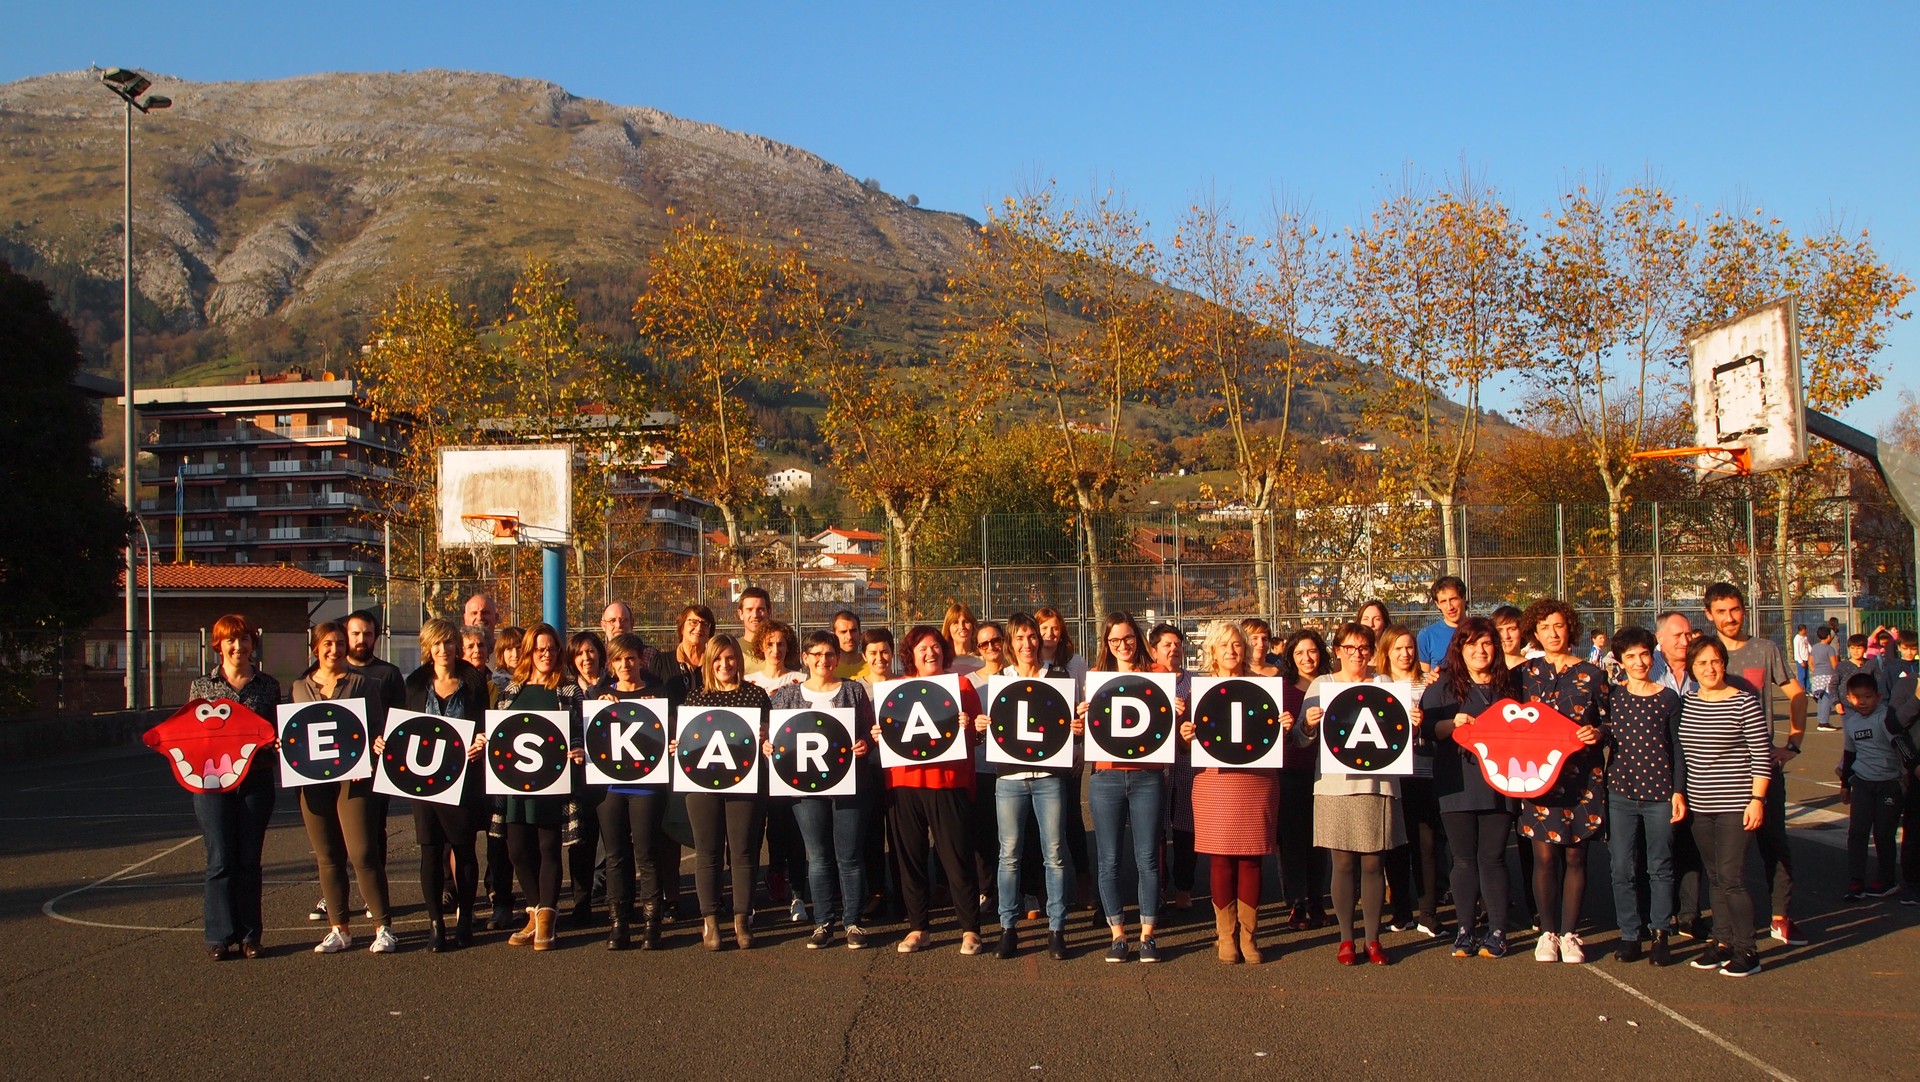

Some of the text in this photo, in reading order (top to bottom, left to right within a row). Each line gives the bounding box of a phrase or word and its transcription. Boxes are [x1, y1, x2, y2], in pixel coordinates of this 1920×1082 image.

[307, 721, 340, 761] E
[406, 734, 446, 777] U
[512, 732, 545, 773] S
[610, 721, 646, 762] K
[696, 730, 737, 770] A
[796, 732, 830, 773] R
[901, 701, 942, 742] A
[1016, 701, 1044, 742] L
[1110, 696, 1151, 738] D
[1345, 708, 1389, 749] A
